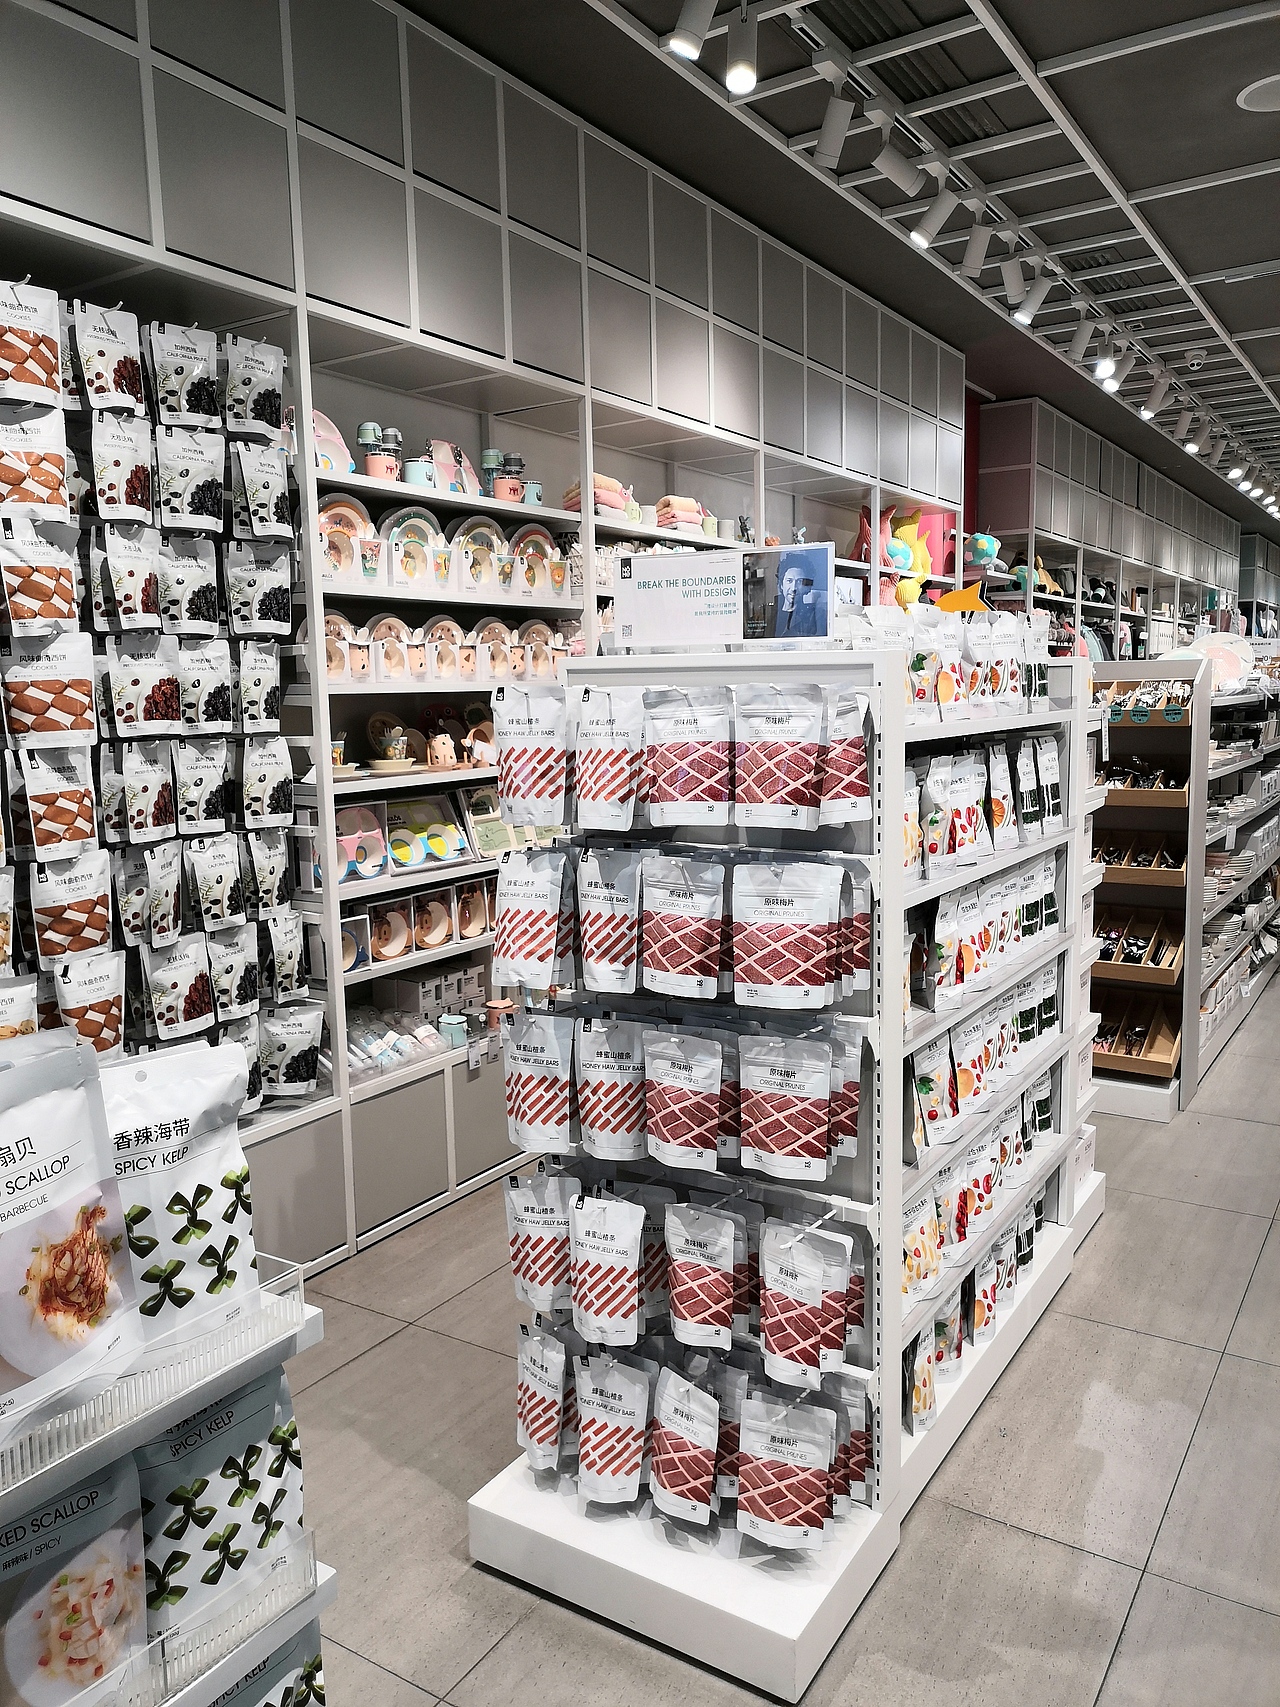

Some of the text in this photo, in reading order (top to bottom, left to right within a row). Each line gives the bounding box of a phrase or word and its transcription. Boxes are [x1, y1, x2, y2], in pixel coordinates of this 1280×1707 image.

[637, 576, 736, 590] BREAK THE BOUNDARIES
[682, 588, 736, 598] WITH DESIGN
[755, 728, 779, 736] ORIGINAL
[64, 884, 88, 894] COOKIES
[534, 892, 549, 900] BARS
[616, 896, 629, 904] BARS
[658, 900, 682, 908] ORIGINAL
[754, 909, 805, 918] ORIGINAL PRUNES
[87, 986, 106, 995] COOKIES
[516, 1044, 546, 1054] 蜂蜜山楂条
[596, 1050, 632, 1060] 蜂蜜山楂条
[546, 1059, 560, 1067] BARS
[582, 1062, 600, 1070] HONEY
[660, 1070, 682, 1080] ORIGINAL
[759, 1078, 806, 1090] ORIGINAL PRUNES
[113, 1117, 190, 1152] 香辣海带
[114, 1145, 188, 1177] SPICY KELP
[5, 1155, 70, 1195] SCALLOP
[0, 1193, 49, 1222] BARBECUE
[523, 1206, 556, 1215] 蜂蜜山楂条
[584, 1230, 616, 1242] 蜂蜜山楂条
[590, 1242, 600, 1250] HAW
[601, 1244, 614, 1253] JELLY
[615, 1246, 629, 1257] BARS
[684, 1238, 709, 1250] 原味梅片
[675, 1247, 717, 1262] ORIGINAL PRUNES
[770, 1275, 788, 1290] ORIGINAL
[548, 1381, 558, 1391] BARS
[591, 1387, 624, 1402] 蜂蜜山楂条
[596, 1400, 608, 1409] HAW
[608, 1404, 621, 1414] JELLY
[621, 1408, 636, 1417] BARS
[664, 1416, 684, 1429] ORIGINAL
[170, 1430, 204, 1457] SPICY
[206, 1410, 235, 1434] KELP
[770, 1434, 799, 1448] 原味梅片
[760, 1444, 808, 1461] ORIGINAL PRUNES
[30, 1490, 99, 1533] SCALLOP
[34, 1536, 62, 1556] SPICY
